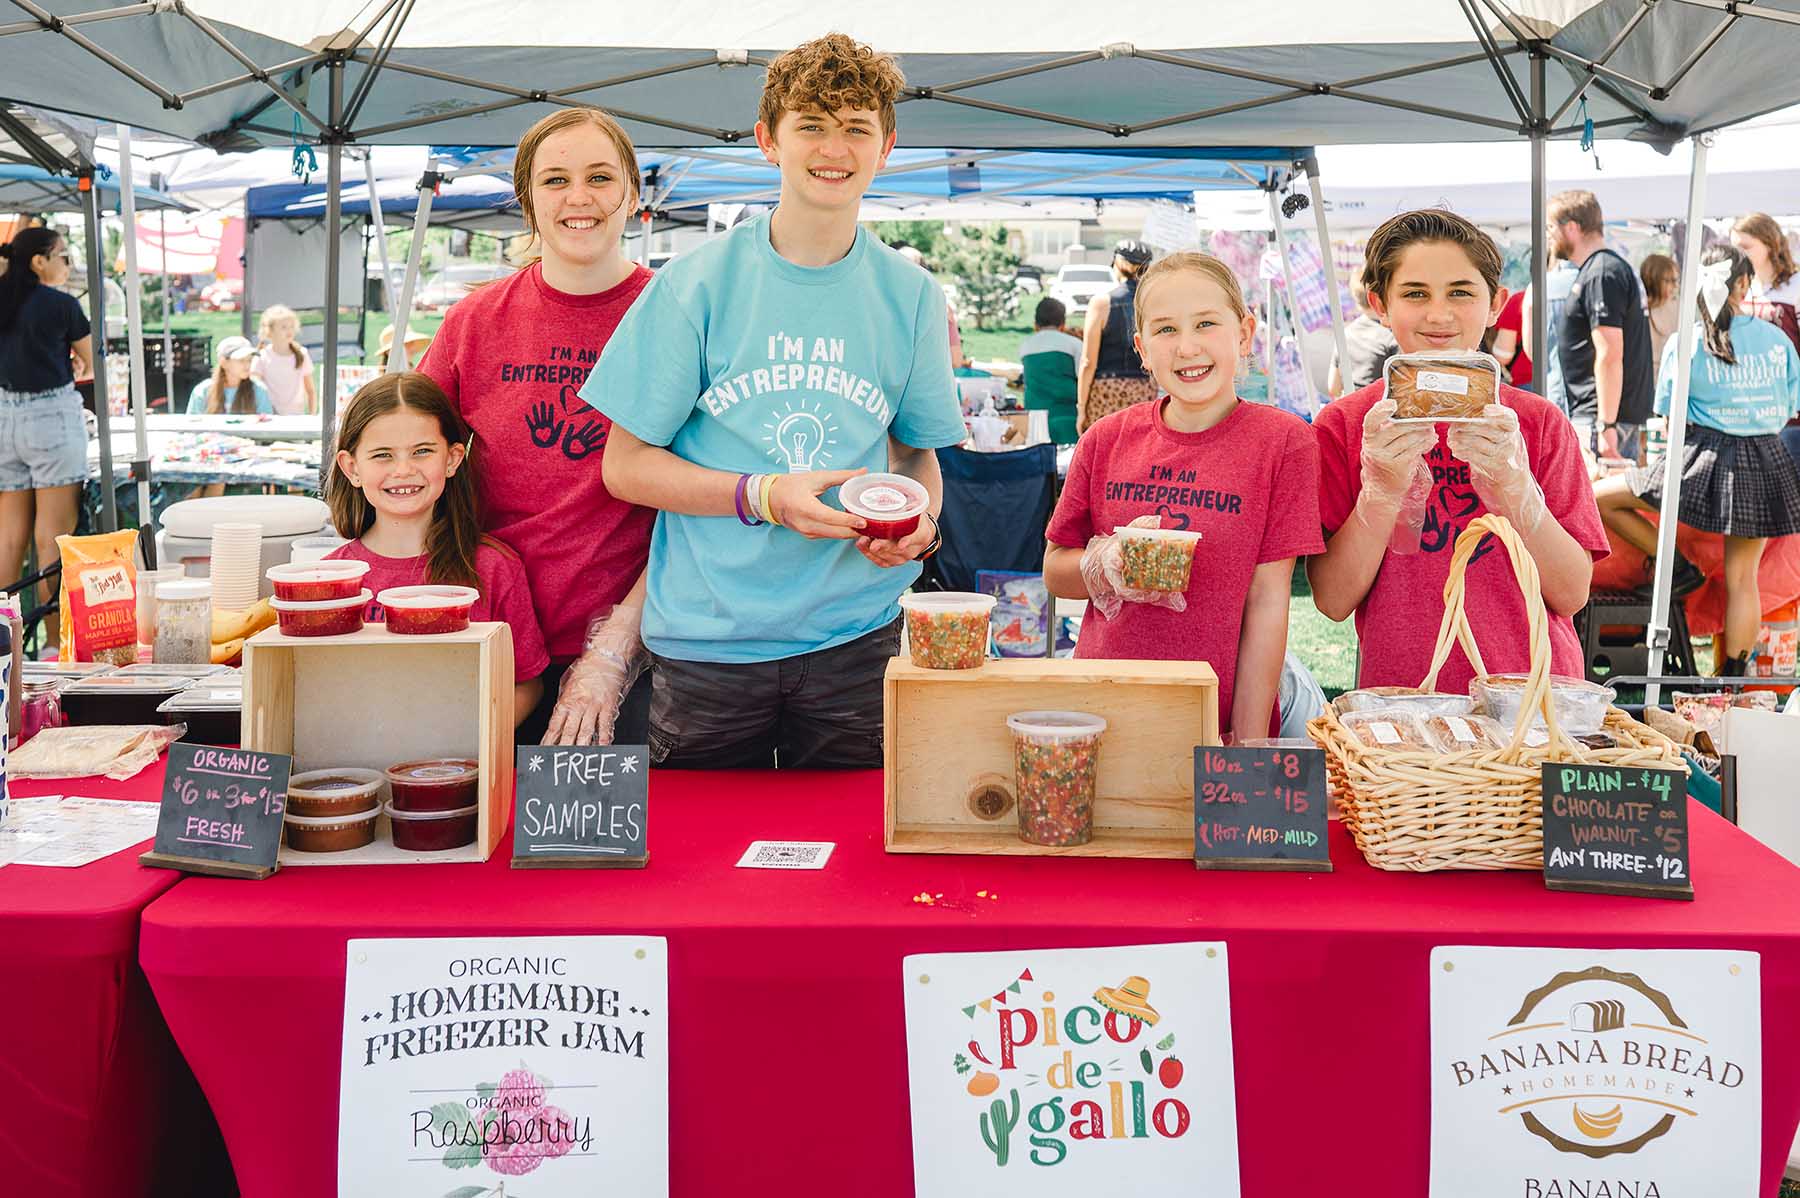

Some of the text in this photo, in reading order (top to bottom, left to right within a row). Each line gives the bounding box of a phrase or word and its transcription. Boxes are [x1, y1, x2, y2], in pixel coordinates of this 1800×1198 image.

[550, 346, 598, 363] I'M AN
[768, 330, 845, 363] I'M AN
[703, 363, 890, 426] ENTREPRENEUR
[1149, 465, 1197, 483] I'M AN
[1106, 481, 1242, 514] ENTREPRENEUR
[88, 608, 133, 630] GRANOLA
[193, 749, 270, 775] ORGANIC
[554, 751, 617, 786] FREE
[1272, 751, 1300, 778] $8
[172, 775, 199, 805] $6
[224, 783, 241, 809] 3
[1274, 785, 1311, 813] $15
[1560, 768, 1622, 793] PLAIN
[1640, 770, 1672, 801] $4
[523, 798, 641, 841] SAMPLES
[1552, 794, 1653, 822] CHOCOLATE
[185, 816, 245, 842] FRESH
[1654, 825, 1683, 853] $5
[1549, 846, 1585, 868] ANY
[449, 956, 567, 977] ORGANIC
[389, 982, 620, 1024] HOMEMADE
[363, 1018, 646, 1067] FREEZER JAM
[997, 990, 1142, 1070] pico
[1046, 1050, 1101, 1089] de
[1451, 1039, 1745, 1089] BANANA BREAD
[1520, 1073, 1675, 1095] HOMEMADE
[465, 1095, 542, 1110] ORGANIC
[410, 1110, 594, 1155] Raspberry
[1027, 1081, 1191, 1166] gallo
[1524, 1178, 1662, 1198] BANANA
